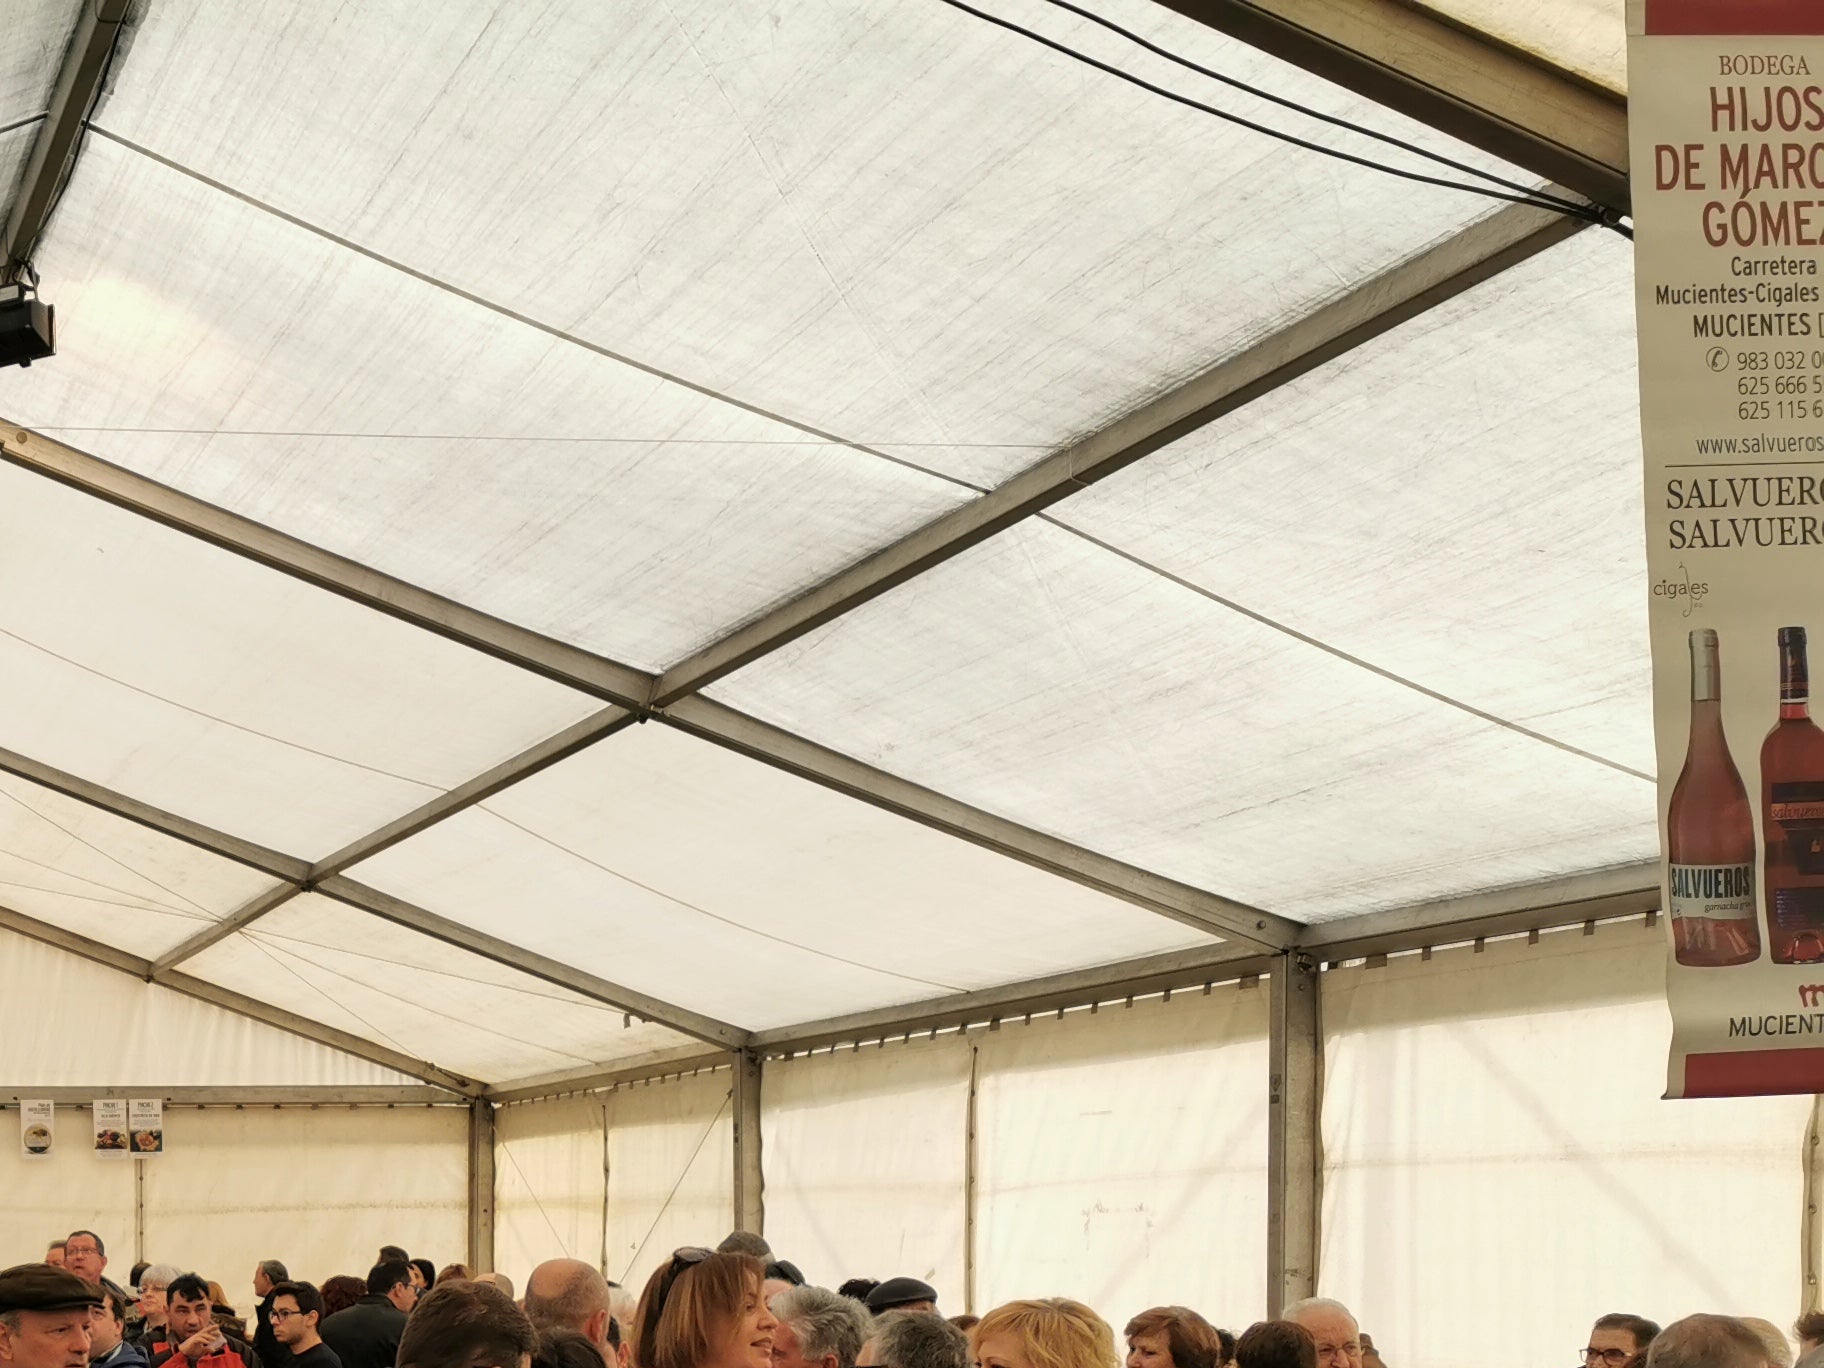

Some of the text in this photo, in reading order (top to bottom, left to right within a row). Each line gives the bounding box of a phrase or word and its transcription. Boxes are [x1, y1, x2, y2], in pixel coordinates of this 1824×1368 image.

[1719, 55, 1811, 76] BODEGA
[1709, 86, 1824, 132] HIJOS
[1655, 144, 1706, 190] DE
[1731, 256, 1817, 276] Carretera
[1656, 282, 1820, 307] Mucientes-Cigales
[1693, 313, 1811, 338] MUCIENTES
[1737, 350, 1824, 370] 983 032 0
[1738, 376, 1769, 395] 625
[1775, 375, 1807, 394] 666
[1739, 401, 1770, 420] 625
[1777, 400, 1807, 419] 115
[1667, 475, 1824, 510] SALVUER
[1669, 516, 1824, 550] SALVUER
[1671, 866, 1751, 899] SALVUEROS
[1704, 901, 1739, 913] garnacha
